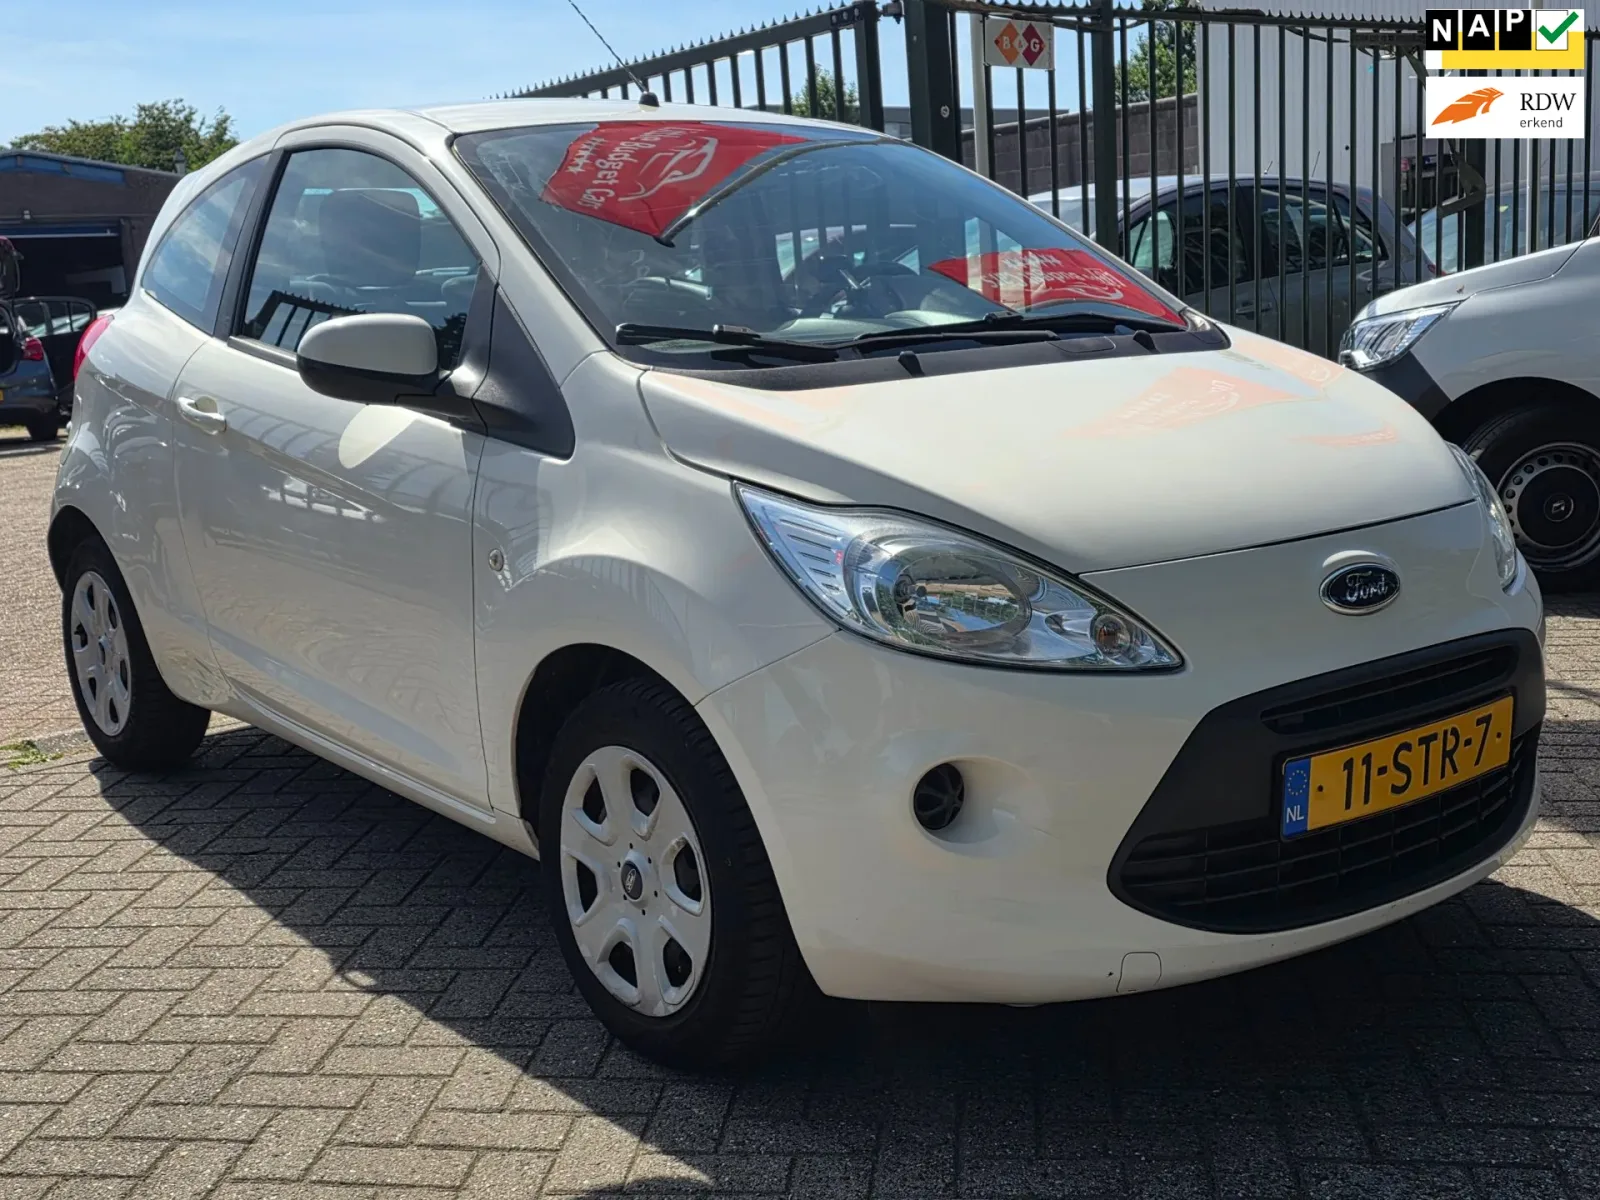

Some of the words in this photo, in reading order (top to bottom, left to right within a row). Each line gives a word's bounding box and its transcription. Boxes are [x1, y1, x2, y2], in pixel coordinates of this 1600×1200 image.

[592, 141, 656, 185] Budget
[1346, 570, 1388, 603] Ford
[1342, 713, 1493, 811] 11-STR-7
[1286, 805, 1305, 824] NL
